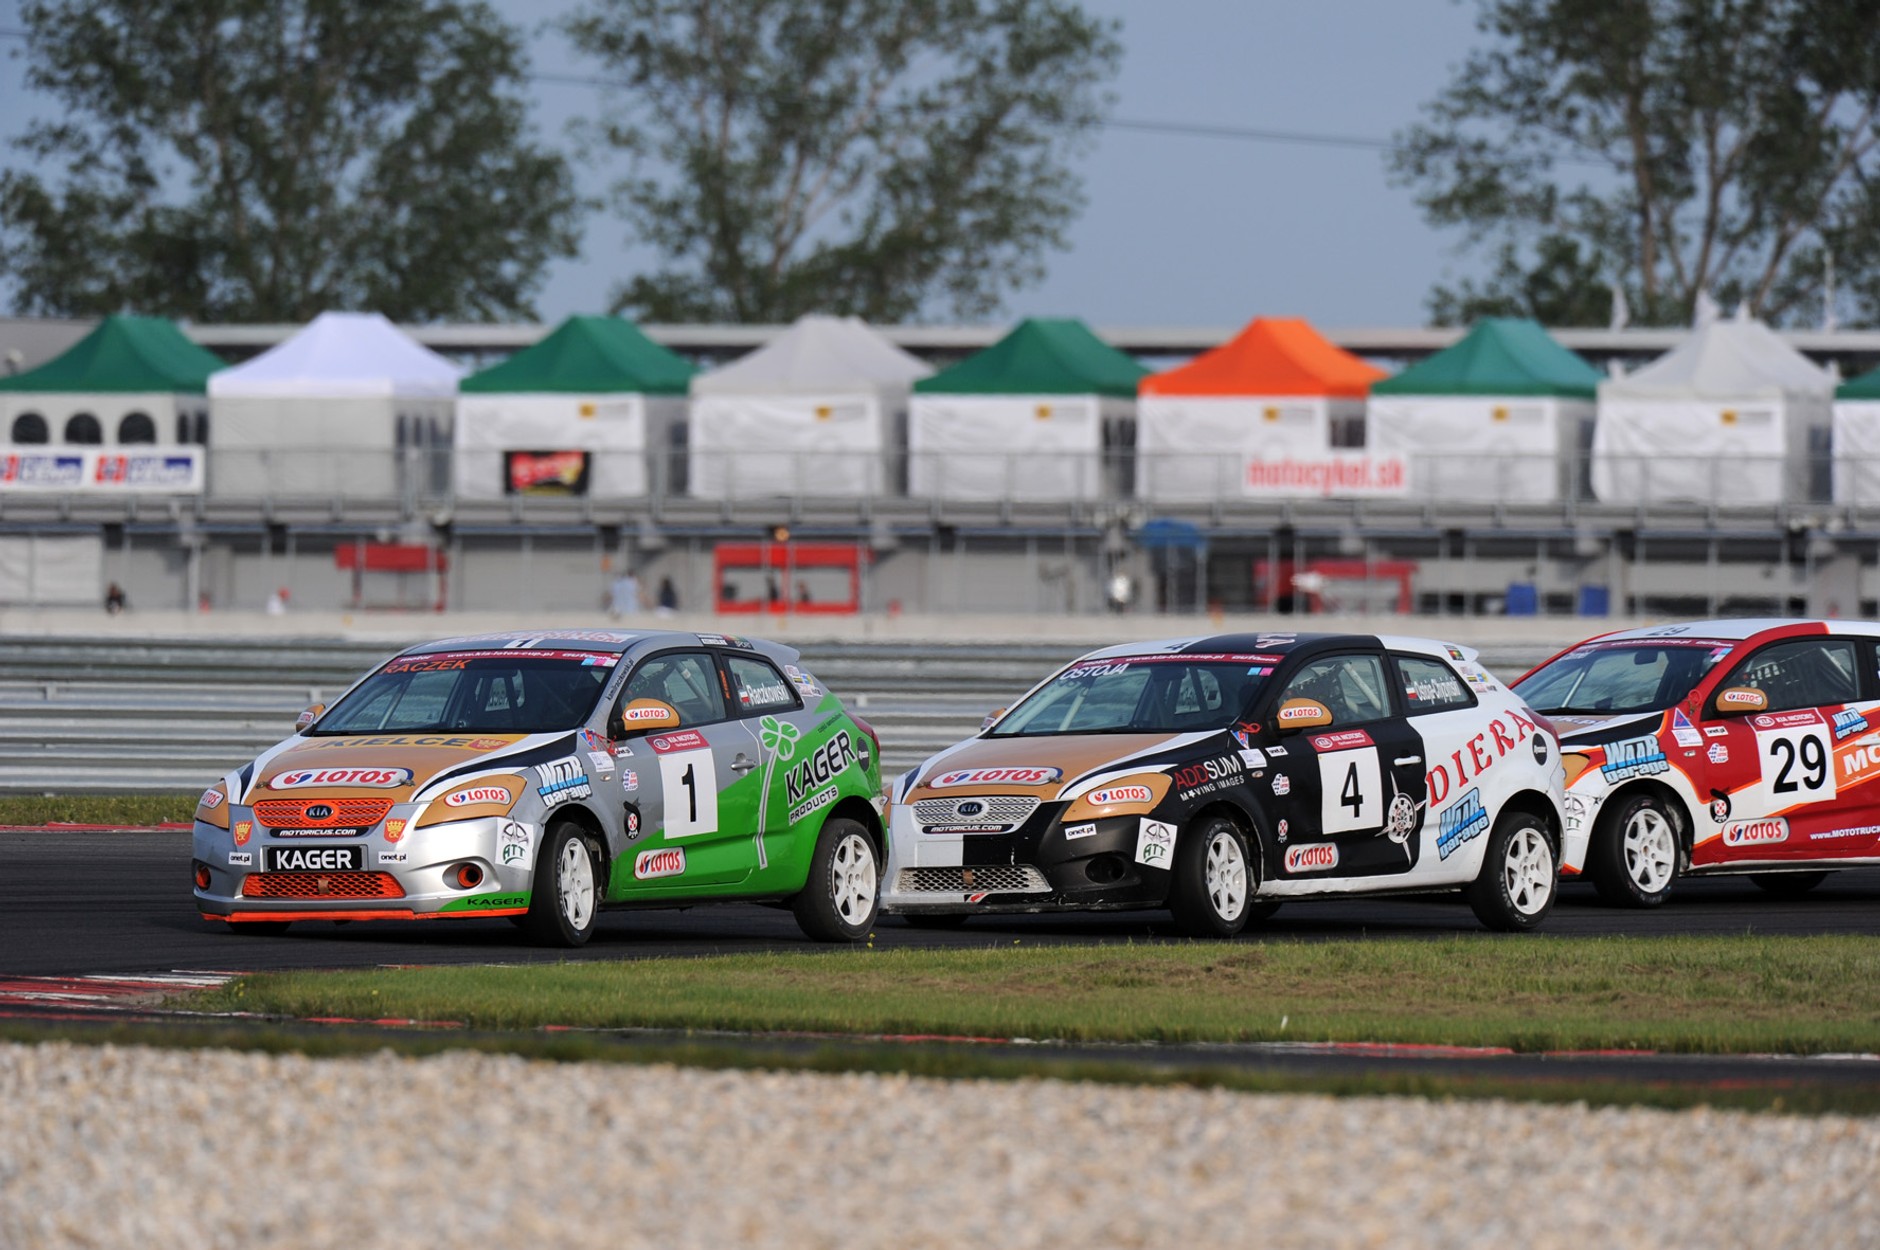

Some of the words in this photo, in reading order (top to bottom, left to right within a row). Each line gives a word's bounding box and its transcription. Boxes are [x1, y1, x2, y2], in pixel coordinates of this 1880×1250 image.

[379, 659, 472, 675] RACZEK
[1059, 663, 1130, 680] OSTOJA
[1735, 693, 1759, 702] LOTOS
[639, 709, 665, 718] LOTOS
[1293, 708, 1318, 717] LOTOS
[322, 737, 474, 748] KIELCE
[1425, 709, 1535, 808] DIERA
[1769, 734, 1827, 794] 29
[786, 731, 856, 805] KAGER
[1174, 755, 1242, 790] ADDSUM
[312, 770, 397, 784] LOTOS
[969, 769, 1048, 782] LOTOS
[1217, 774, 1245, 789] IMAGES
[467, 789, 505, 801] LOTOS
[681, 763, 697, 823] 1
[1110, 788, 1146, 800] LOTOS
[1341, 761, 1363, 818] 4
[308, 805, 328, 816] KIA
[790, 787, 837, 823] PRODUCTS
[960, 804, 978, 813] KIA
[930, 824, 1002, 833] MOTORICUS.COM
[1566, 816, 1582, 828] TT
[279, 829, 356, 837] MOTORICUS.COM
[1068, 827, 1094, 837] onet.pl
[1743, 821, 1782, 841] LOTOS
[229, 853, 251, 864] onet.pl
[275, 849, 353, 870] KAGER
[380, 853, 407, 862] onet.pl
[650, 851, 681, 870] LOTOS
[1301, 846, 1333, 866] LOTOS
[466, 898, 525, 906] KAGER
